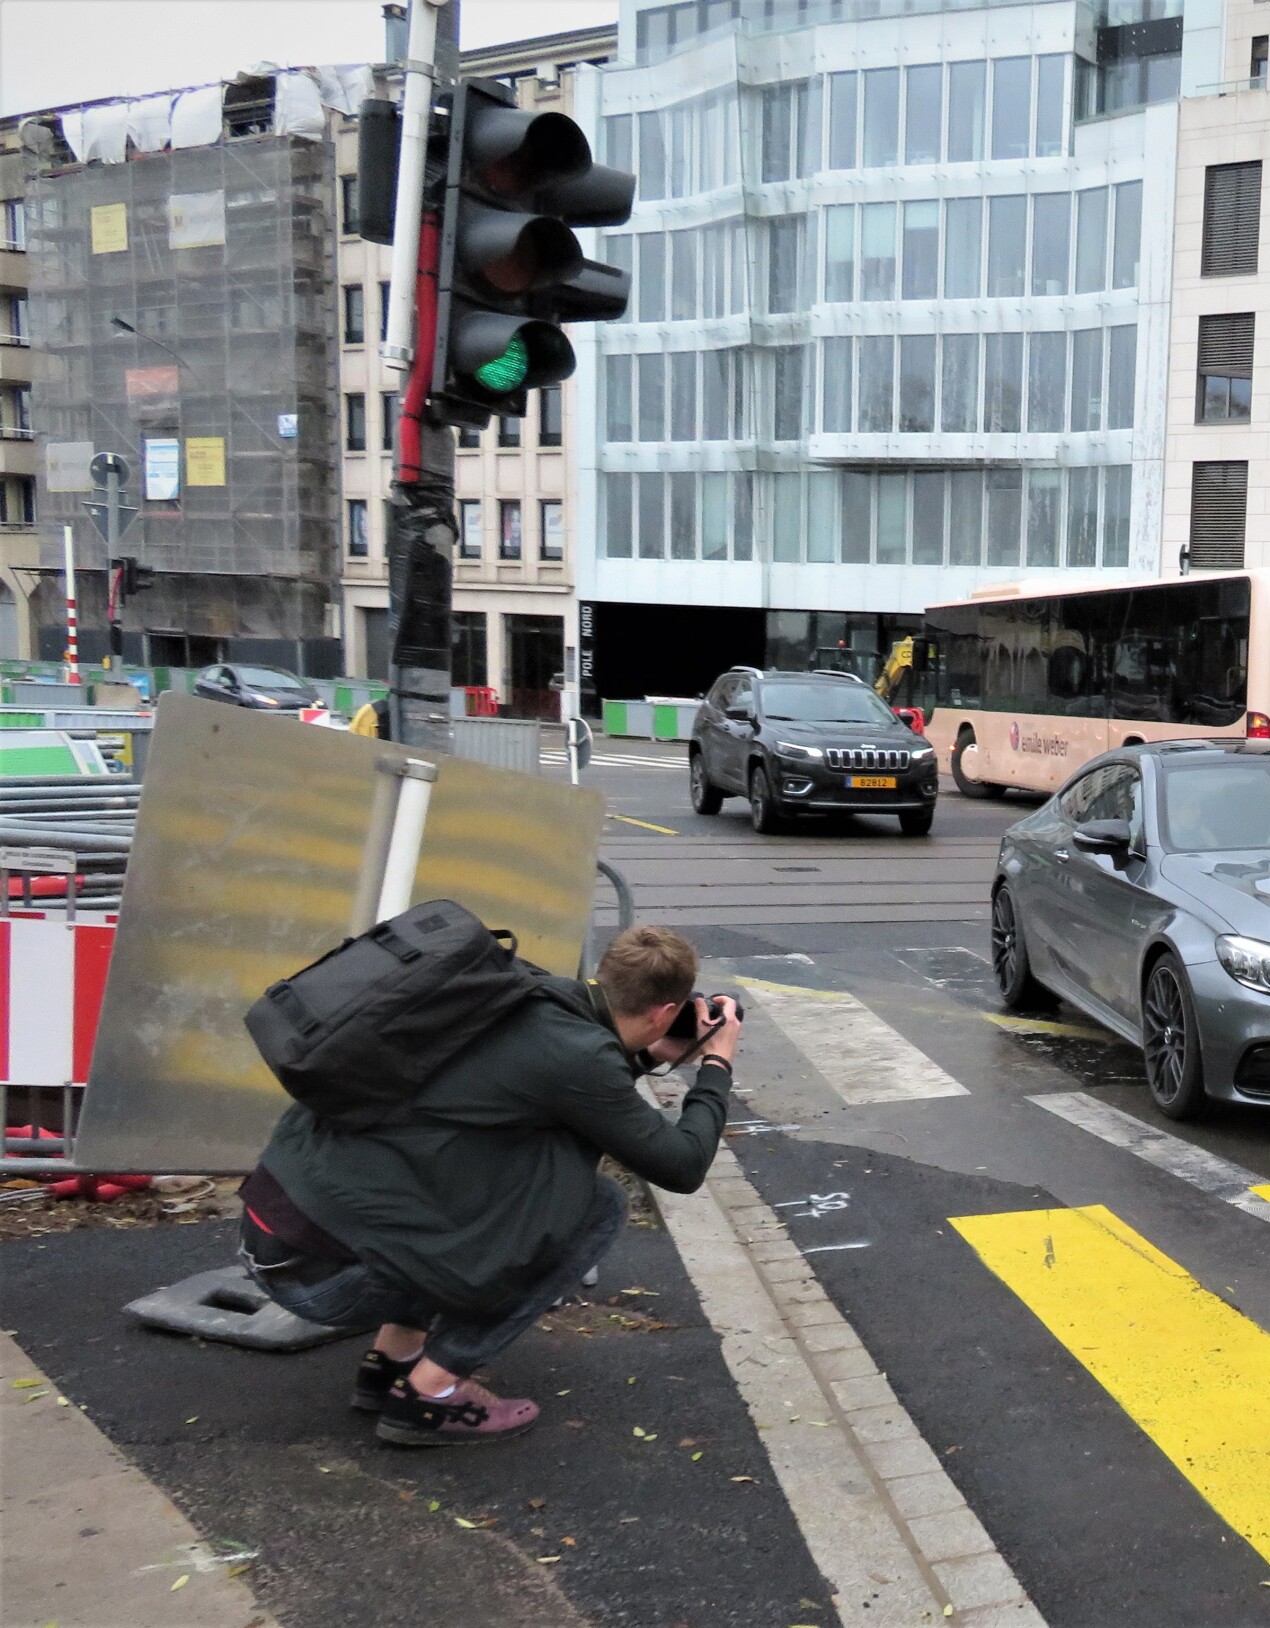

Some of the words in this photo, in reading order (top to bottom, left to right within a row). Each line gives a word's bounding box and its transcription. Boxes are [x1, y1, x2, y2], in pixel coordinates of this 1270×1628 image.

[581, 606, 593, 637] NORD
[581, 649, 593, 677] POLE
[1021, 732, 1042, 754] emile
[1043, 734, 1068, 757] weber
